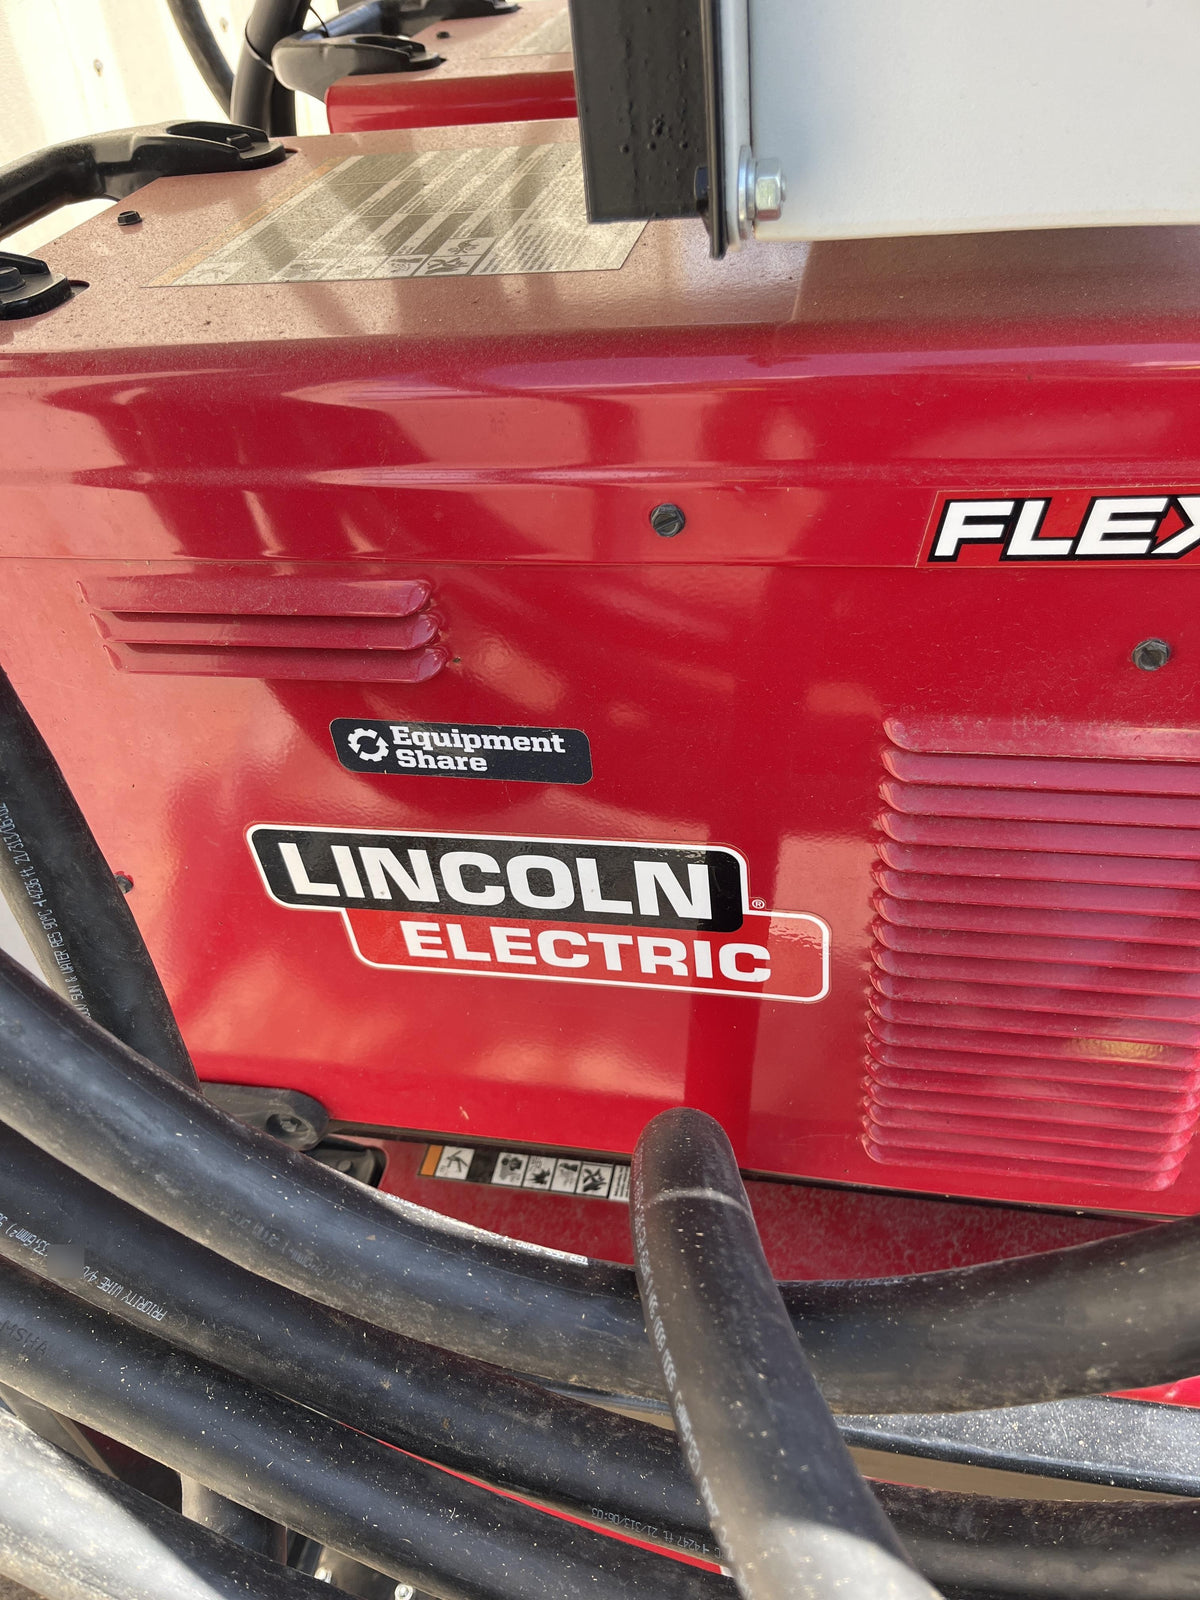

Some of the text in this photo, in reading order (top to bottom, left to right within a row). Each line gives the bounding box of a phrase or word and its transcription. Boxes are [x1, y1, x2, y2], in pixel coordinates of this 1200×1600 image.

[389, 725, 565, 753] Equipment
[395, 749, 488, 772] Share
[277, 842, 712, 920] LINCOLN
[47, 931, 65, 948] RES
[399, 920, 772, 982] ELECTRIC
[53, 949, 75, 975] WATER
[64, 975, 78, 983] &
[68, 984, 84, 1001] SUN
[96, 1276, 124, 1299] WIRE
[122, 1289, 168, 1322] PRIORITY
[591, 1506, 659, 1538] 21/313/06:03
[677, 1534, 701, 1552] 4247
